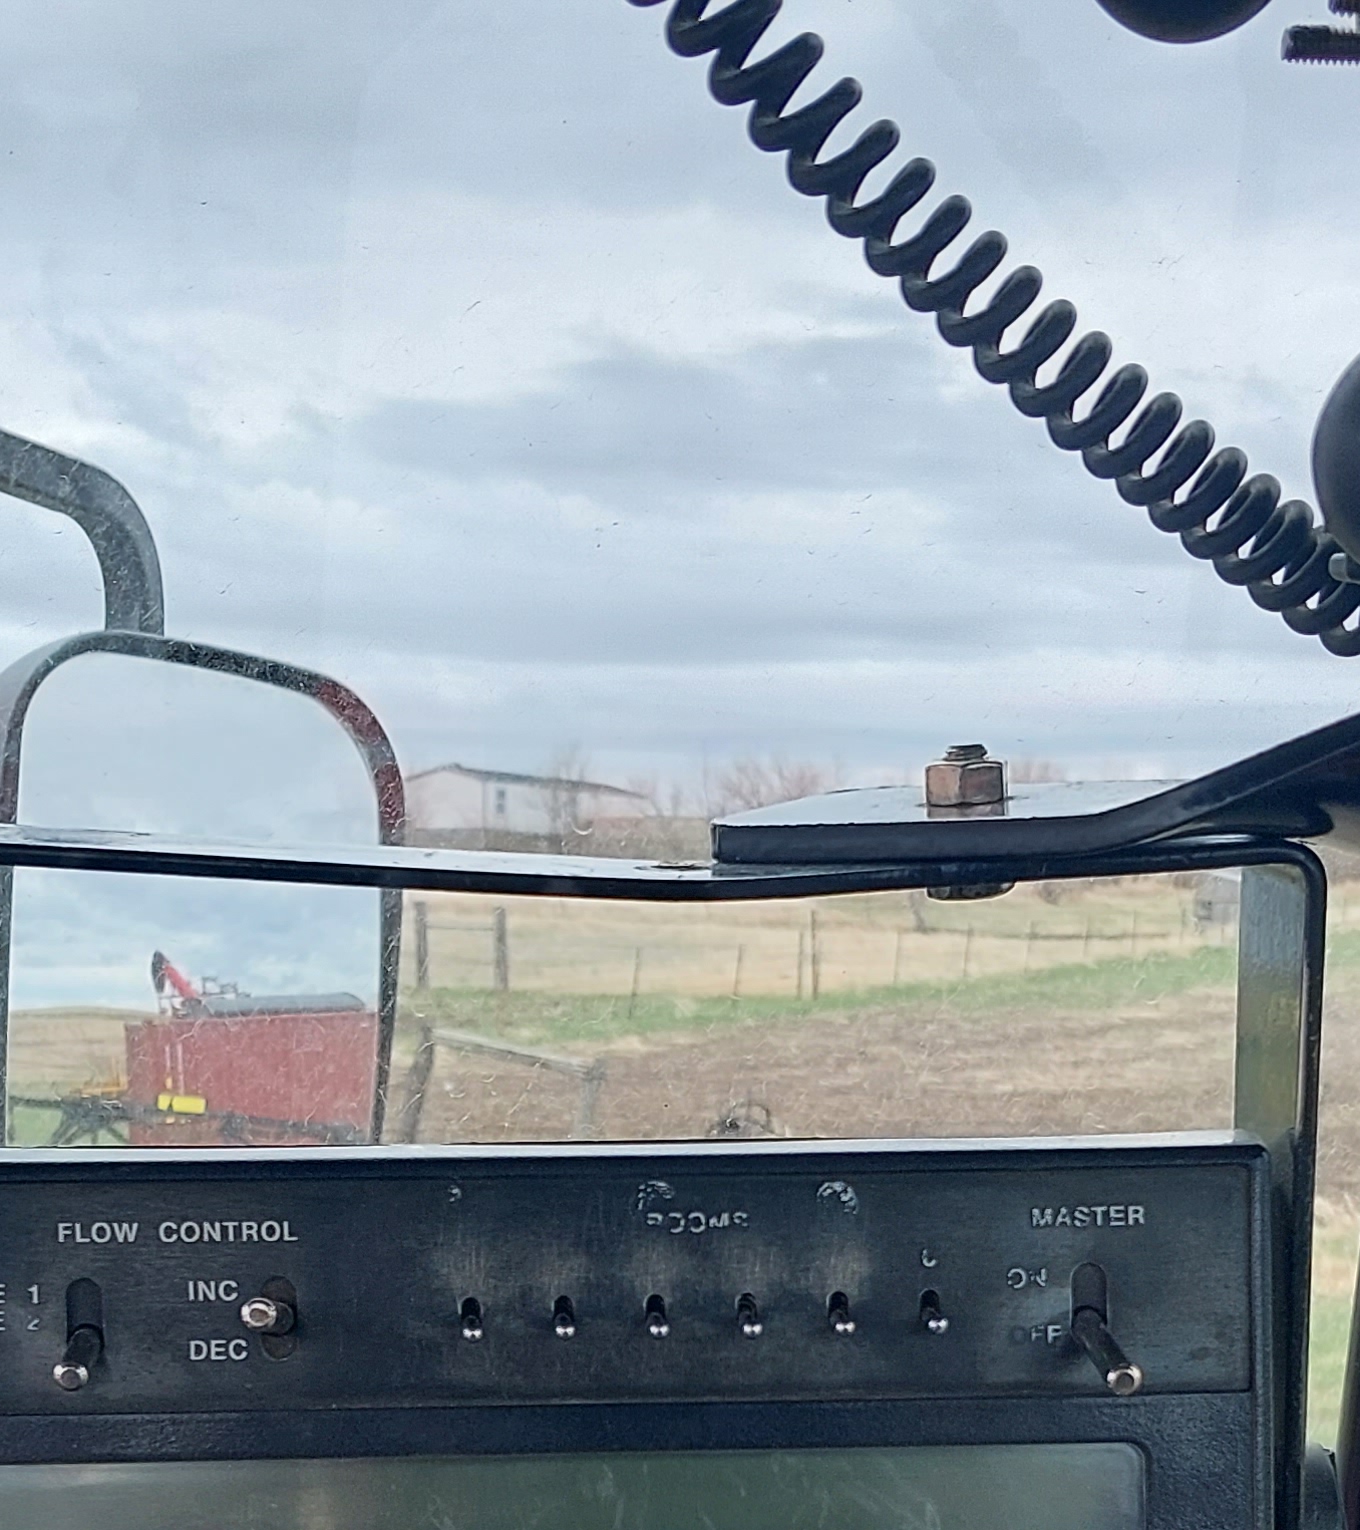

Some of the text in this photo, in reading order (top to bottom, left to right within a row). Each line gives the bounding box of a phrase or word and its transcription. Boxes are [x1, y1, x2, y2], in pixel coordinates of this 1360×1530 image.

[1031, 1205, 1145, 1227] MASTER
[57, 1220, 299, 1243] FLOW CONTROL
[27, 1284, 39, 1304] 1
[188, 1280, 238, 1302] INC
[189, 1340, 248, 1362] DEC
